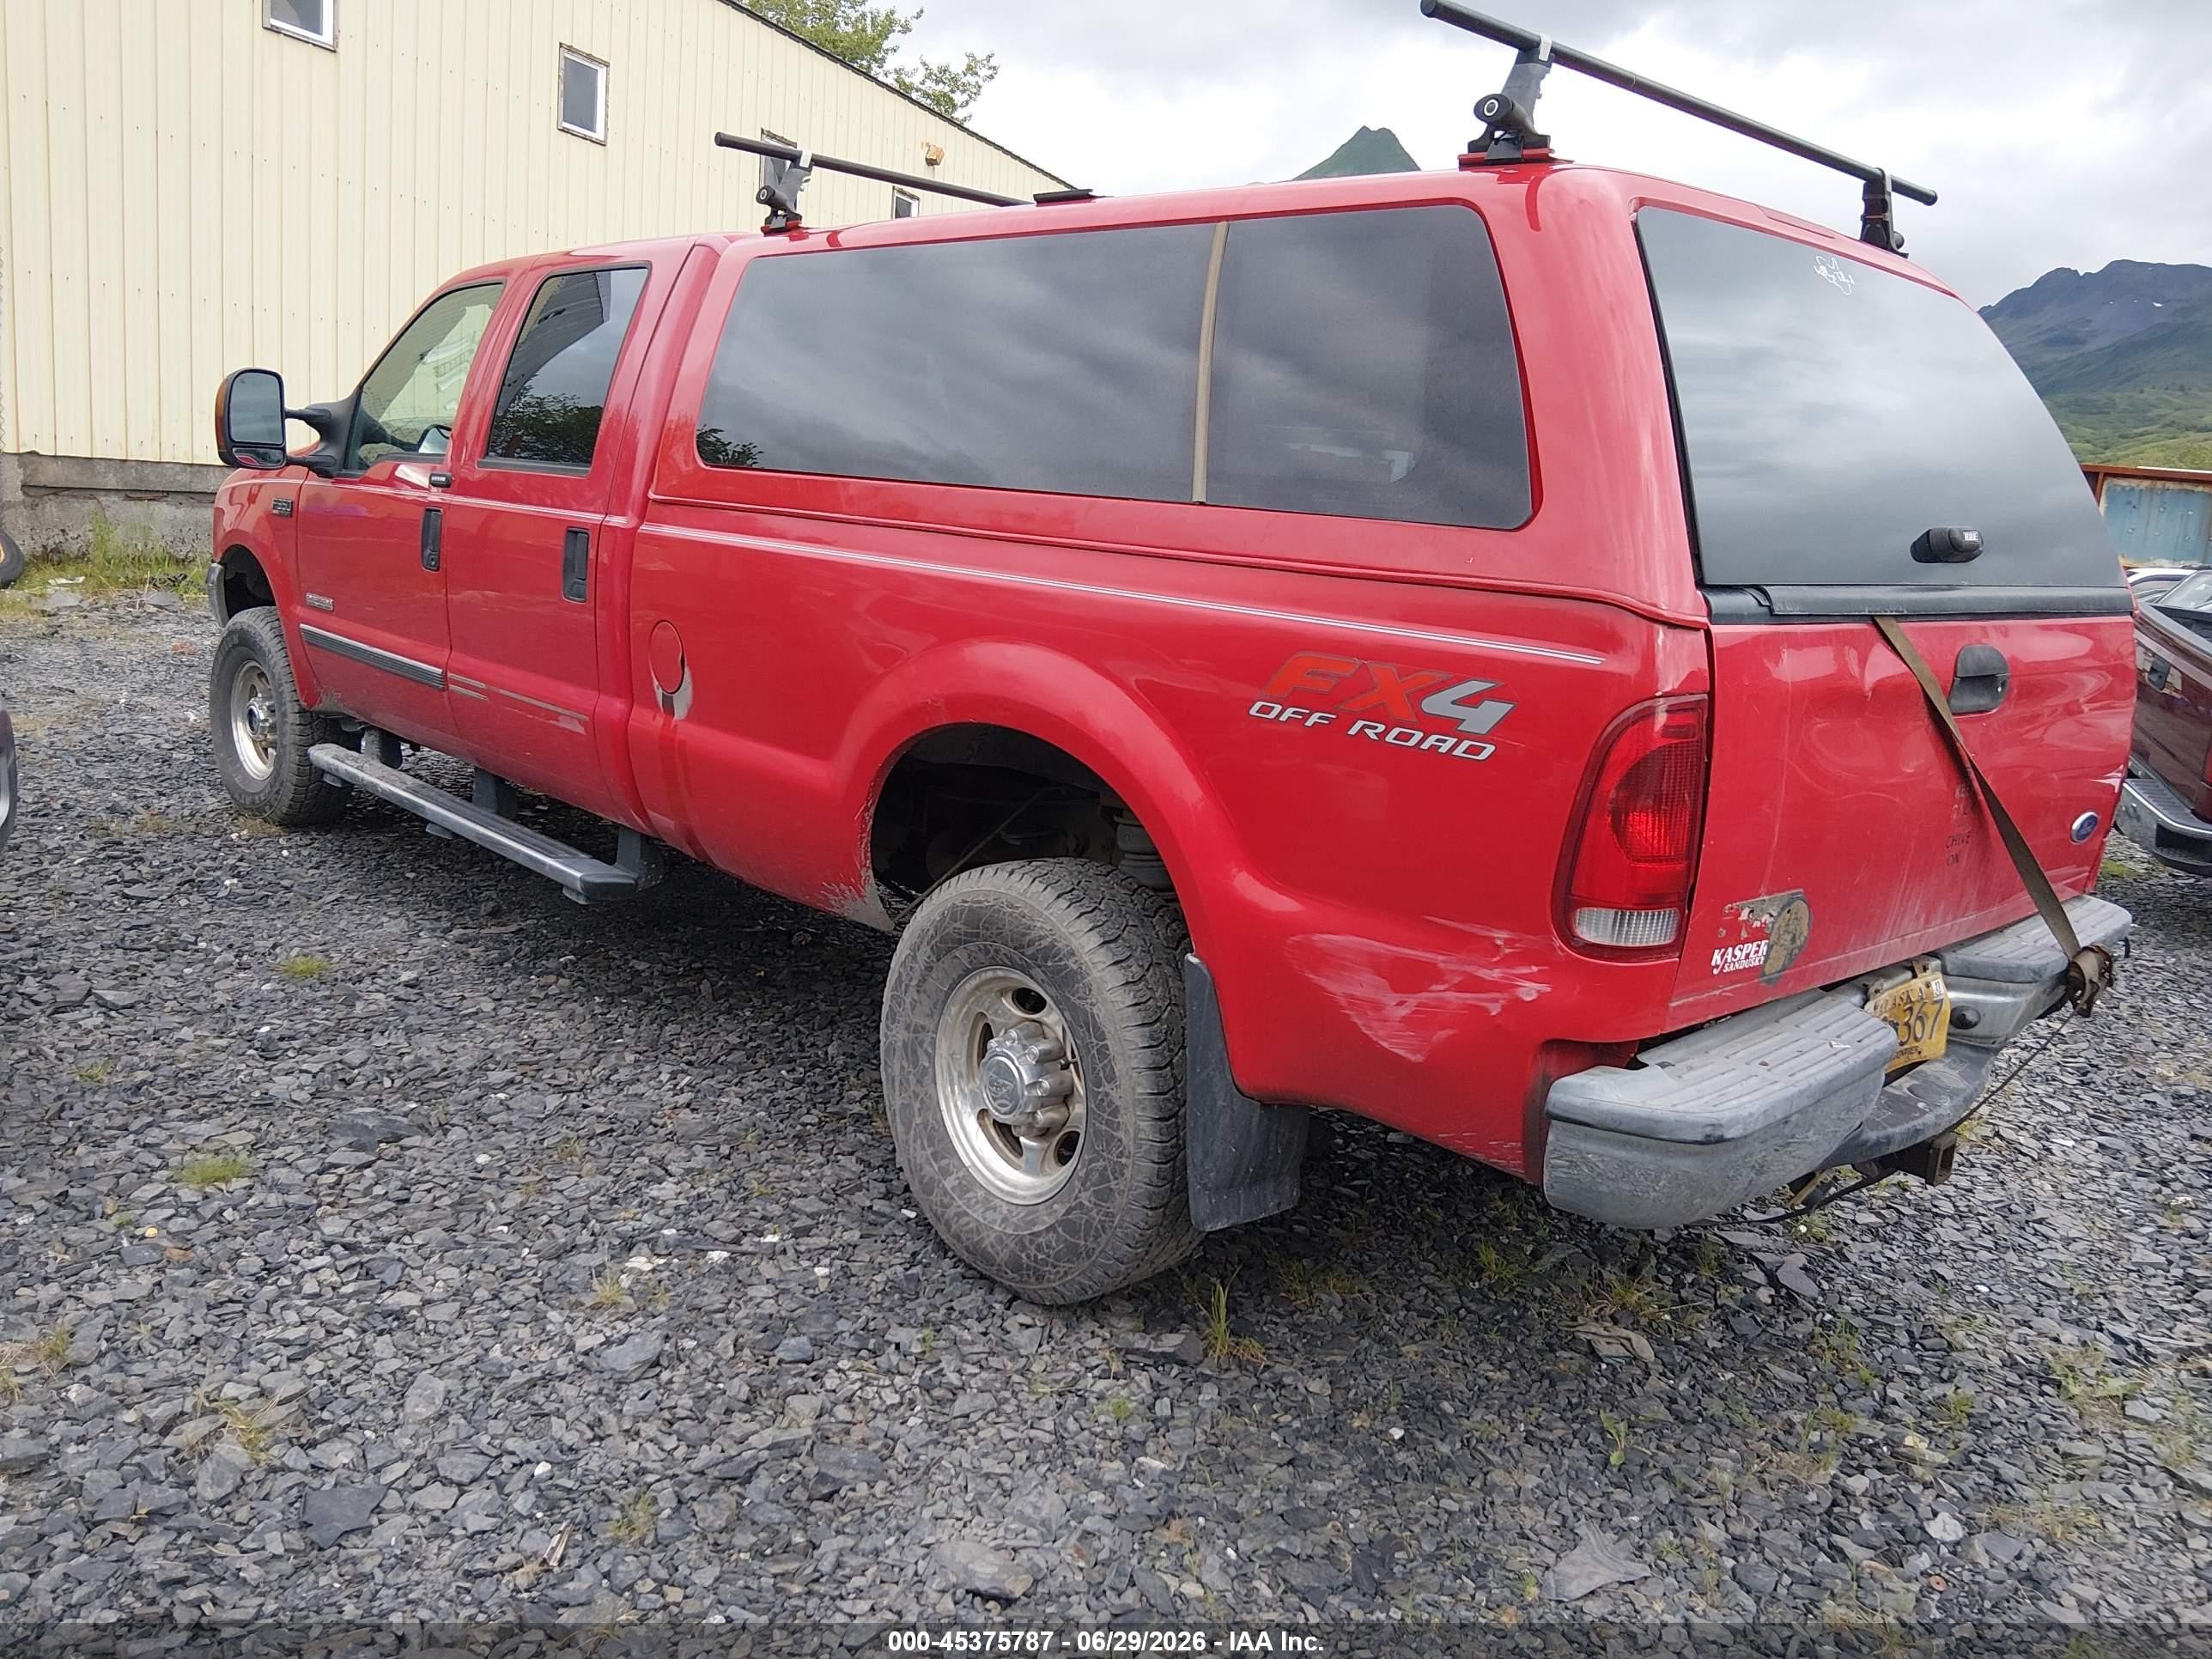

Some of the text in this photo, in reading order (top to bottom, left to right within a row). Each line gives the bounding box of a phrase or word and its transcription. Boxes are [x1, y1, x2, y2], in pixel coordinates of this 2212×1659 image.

[1261, 651, 1516, 735] FX4
[1248, 700, 1497, 761] OFF ROAD
